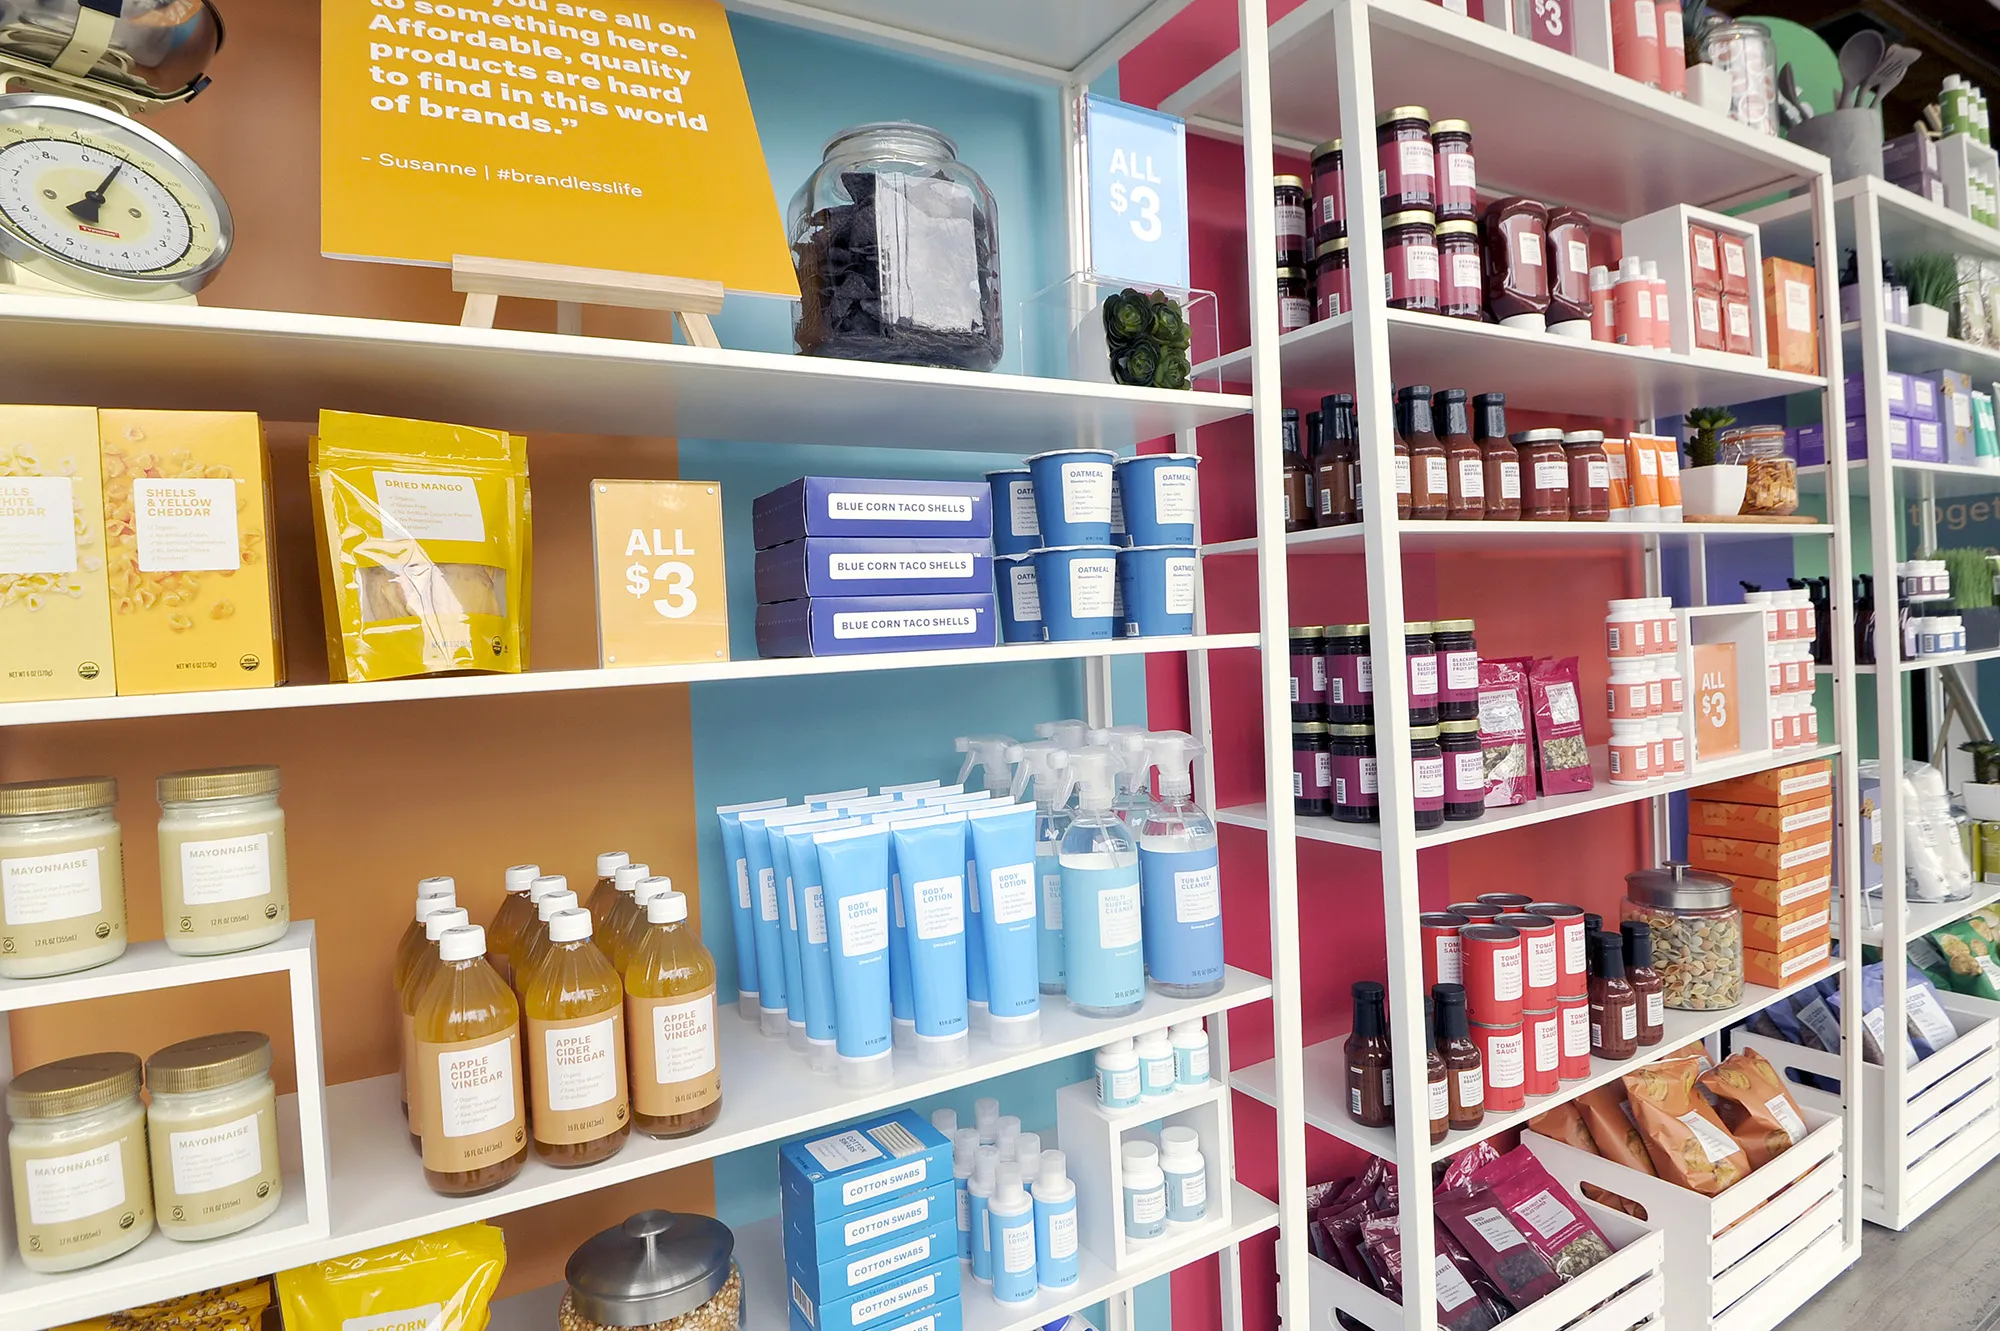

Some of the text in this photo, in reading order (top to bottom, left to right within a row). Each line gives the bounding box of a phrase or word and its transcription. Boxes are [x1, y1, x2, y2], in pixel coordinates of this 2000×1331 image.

[556, 3, 607, 22] are
[615, 13, 651, 31] all
[659, 22, 696, 39] on
[414, 1, 600, 47] something
[607, 30, 687, 59] here.
[369, 14, 691, 85] Affordable, quality
[369, 42, 682, 104] products are hard
[369, 66, 708, 131] to find in this world
[370, 95, 410, 113] of
[1109, 149, 1161, 184] ALL
[378, 153, 477, 176] Susanne
[497, 167, 643, 197] #brandlesslife
[146, 489, 196, 497] SHELLS
[385, 480, 463, 491] DRIED MANGO
[147, 498, 211, 507] & YELLOW
[836, 502, 965, 513] BLUE CORN TACO SHELLS
[148, 508, 211, 516] CHEDDAR
[625, 528, 695, 556] ALL
[837, 561, 966, 571] BLUE CORN TACO SHELLS
[842, 617, 969, 630] BLUE CORN TACO SHELLS
[1702, 671, 1725, 691] ALL
[189, 843, 260, 858] MAYONNAISE
[11, 859, 88, 876] MAYONNAISE
[999, 873, 1019, 881] BODY
[1000, 879, 1027, 889] LOTION
[923, 887, 944, 895] BODY
[1182, 881, 1209, 890] CLEANER
[848, 901, 869, 911] BODY
[923, 894, 953, 903] LOTION
[849, 907, 878, 919] LOTION
[1501, 959, 1519, 967] SAUCE
[664, 1010, 696, 1023] APPLE
[664, 1019, 695, 1032] CIDER
[665, 1024, 707, 1040] VINEGAR
[556, 1035, 591, 1047] APPLE
[556, 1045, 590, 1057] CIDER
[557, 1050, 605, 1066] VINEGAR
[451, 1056, 488, 1070] APPLE
[451, 1066, 487, 1080] CIDER
[452, 1071, 503, 1090] VINEGAR
[179, 1125, 249, 1148] MAYONNAISE
[846, 1135, 868, 1153] COTTON
[34, 1154, 110, 1176] MAYONNAISE
[850, 1168, 920, 1197] COTTON SWABS
[852, 1207, 922, 1237] COTTON SWABS
[854, 1246, 924, 1277] COTTON SWABS
[858, 1296, 897, 1316] COTTON
[898, 1284, 929, 1301] SWABS
